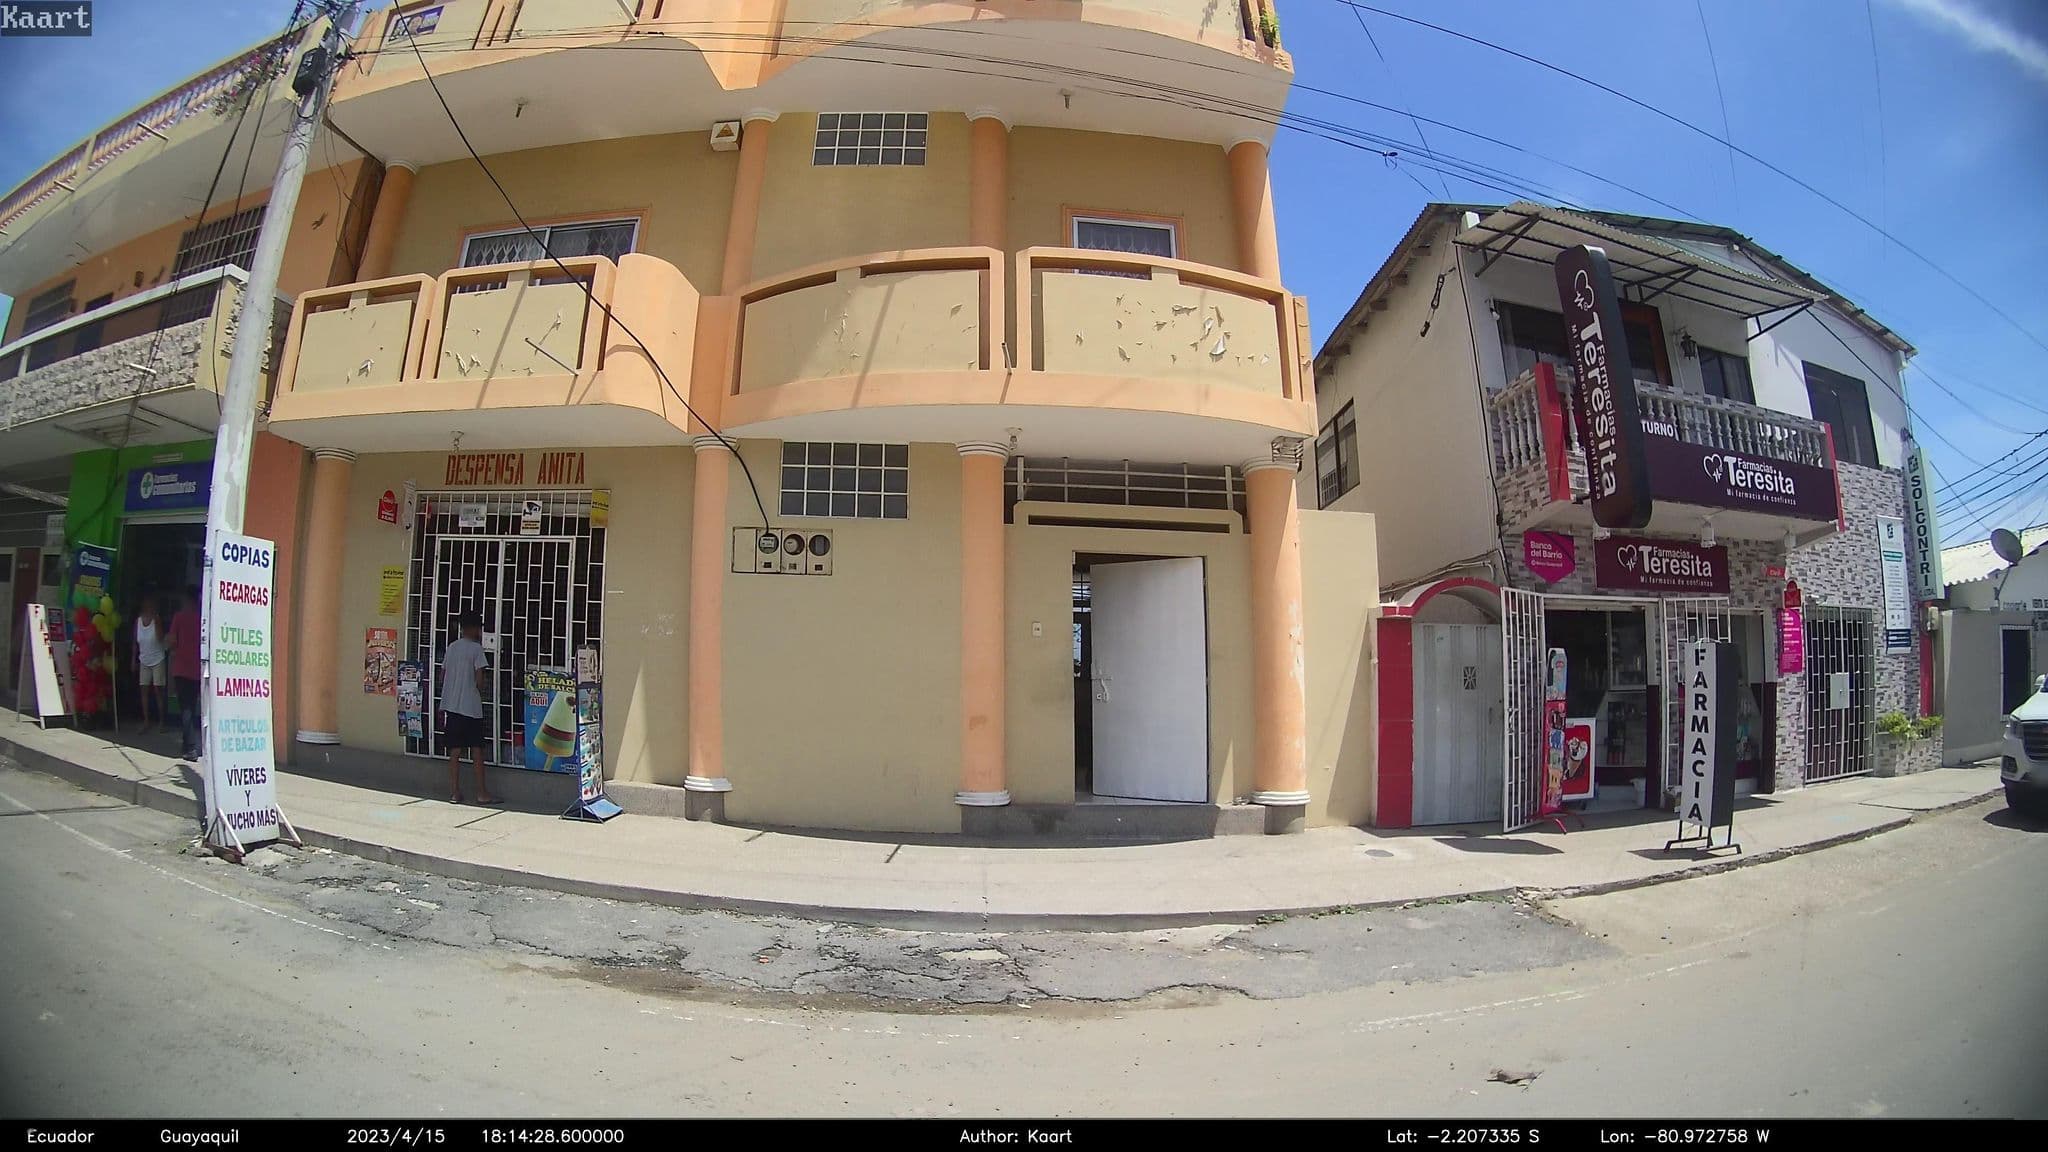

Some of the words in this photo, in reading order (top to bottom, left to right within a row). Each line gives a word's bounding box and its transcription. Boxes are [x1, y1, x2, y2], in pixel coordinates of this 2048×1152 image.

[1597, 344, 1617, 437] Farmacias
[1580, 311, 1617, 497] Teresita
[1641, 419, 1674, 438] TURNO
[445, 453, 524, 486] DESPENSA
[537, 452, 585, 485] ANITA
[1723, 455, 1795, 495] Teresita
[1737, 457, 1773, 474] Farmacias
[1911, 475, 1931, 587] SOLCONTRI
[221, 542, 270, 569] COPIAS
[1530, 541, 1552, 550] Banco
[1530, 549, 1542, 558] del
[1543, 550, 1563, 560] Barrio
[1653, 546, 1690, 559] Farmacias
[1638, 545, 1712, 577] Teresita
[219, 580, 269, 607] RECARGAS
[220, 622, 263, 647] ÚTILES
[215, 649, 270, 668] ESCOLARES
[216, 677, 270, 698] LAMINAS
[218, 716, 269, 735] ARTÍCULOS
[1688, 648, 1710, 822] FARMACIA
[221, 737, 233, 752] DE
[235, 736, 267, 752] BAZAR
[226, 765, 267, 787] VÍVERES
[245, 790, 252, 807] Y
[256, 806, 276, 828] MÁS
